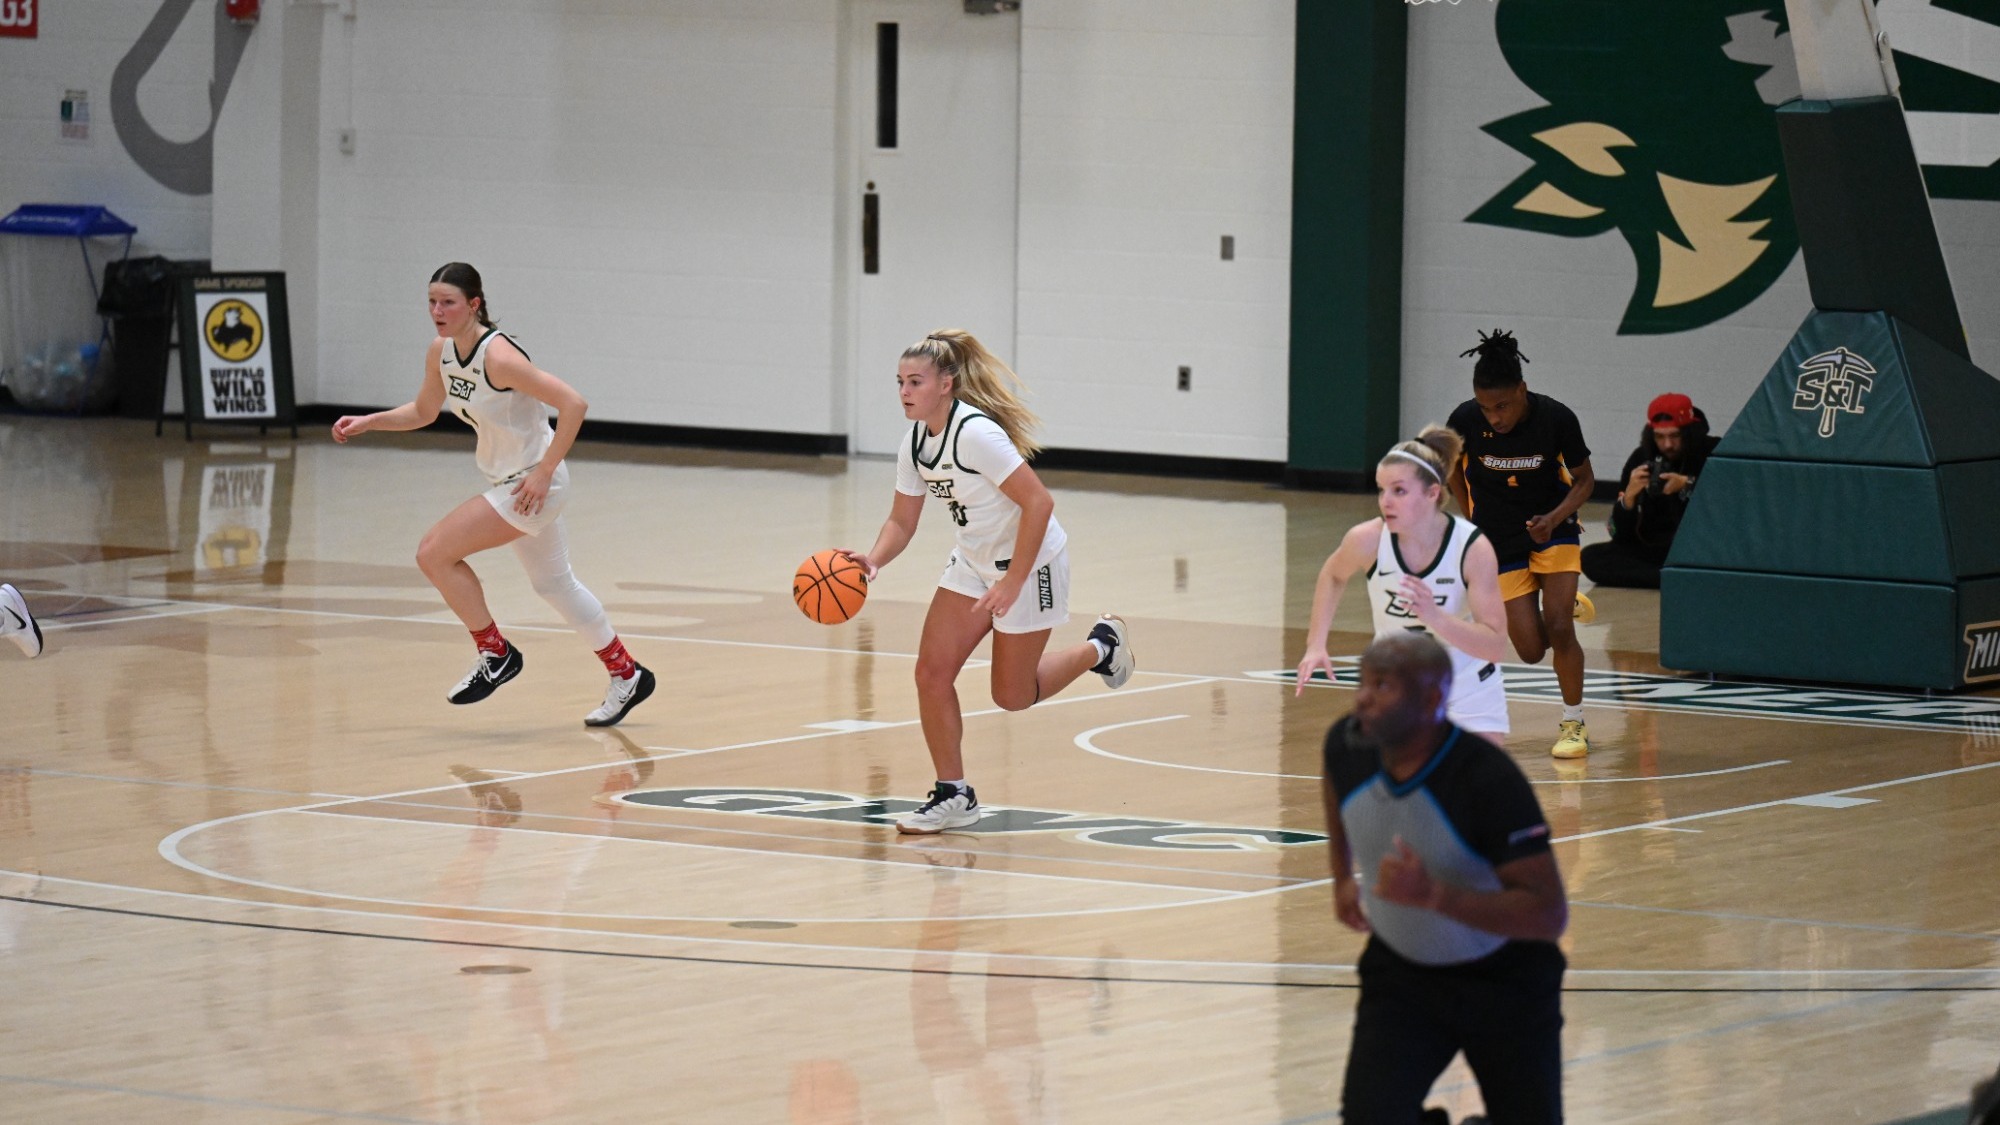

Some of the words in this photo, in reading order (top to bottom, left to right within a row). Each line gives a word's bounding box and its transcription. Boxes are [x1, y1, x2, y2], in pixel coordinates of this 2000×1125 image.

[210, 367, 264, 379] BUFFALO
[212, 380, 266, 398] WILD
[449, 376, 476, 400] S&T
[1793, 367, 1873, 414] S&T
[214, 399, 267, 413] WINGS
[1483, 454, 1543, 469] SPALDING
[1039, 565, 1053, 611] MINERS
